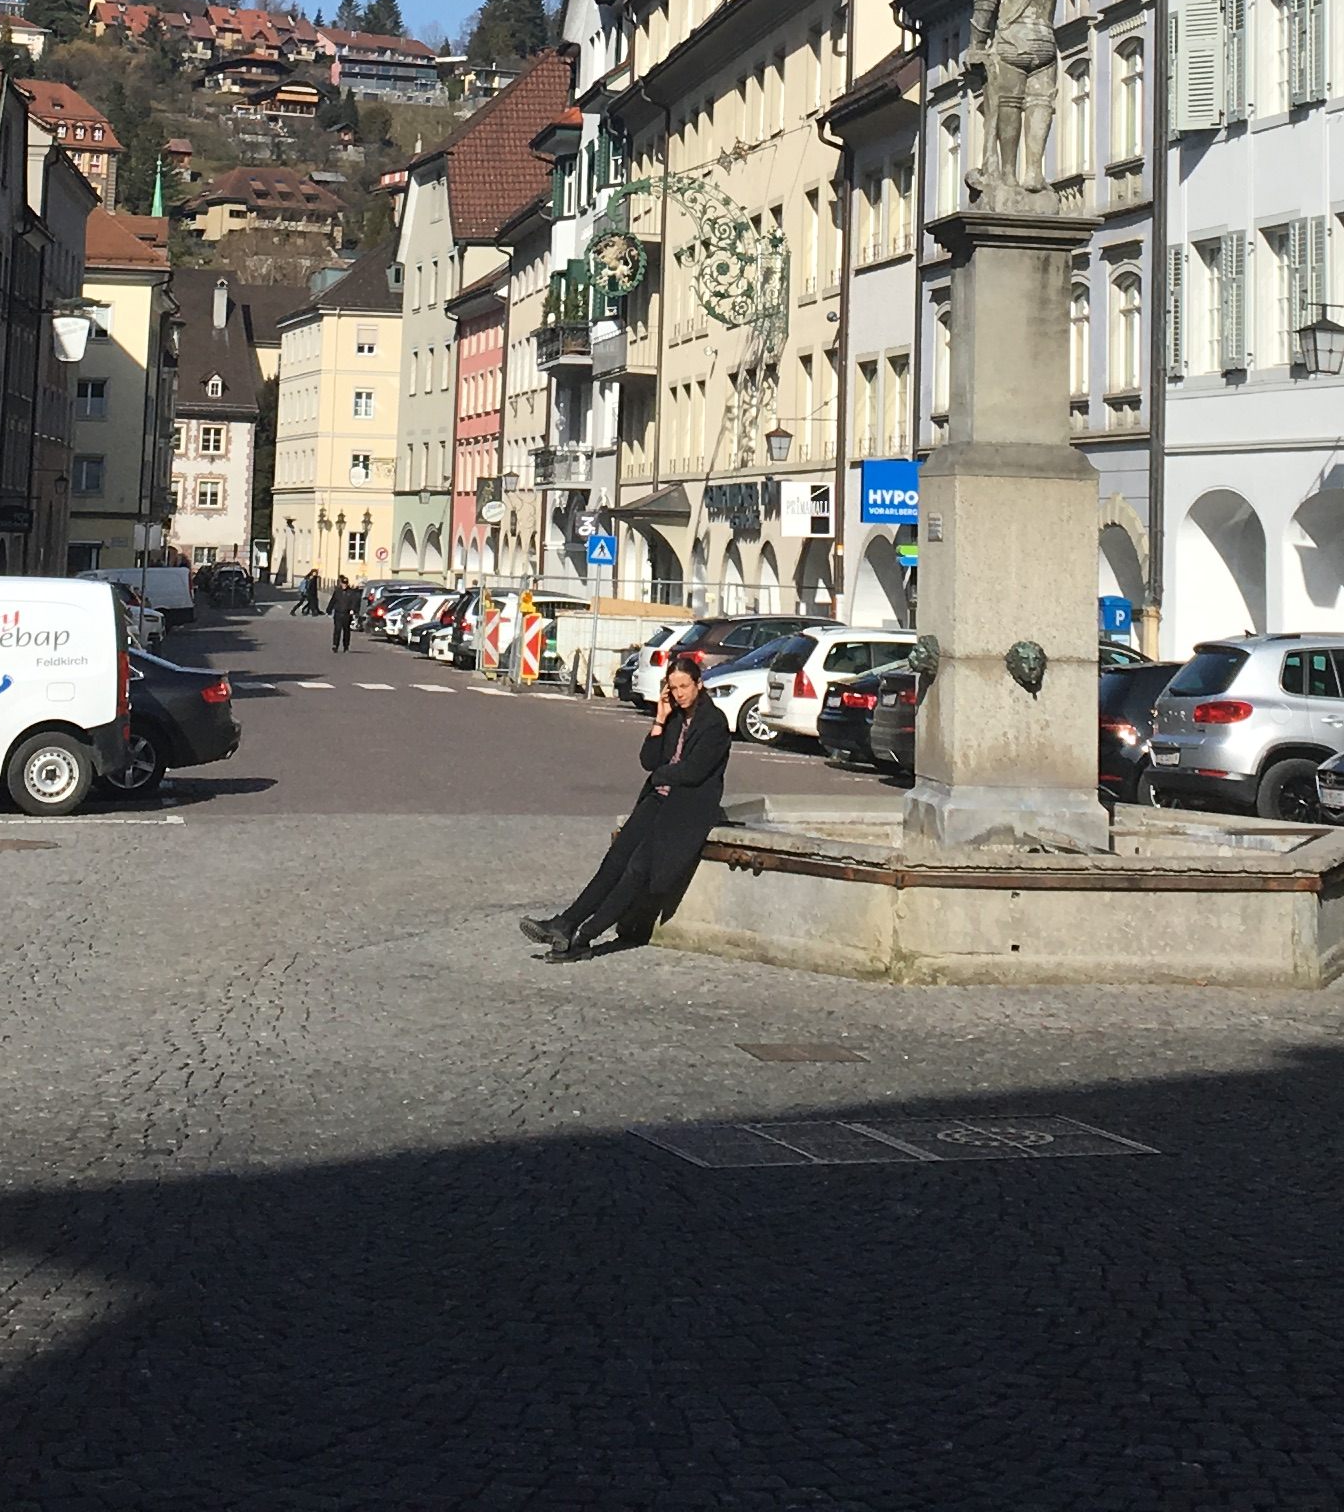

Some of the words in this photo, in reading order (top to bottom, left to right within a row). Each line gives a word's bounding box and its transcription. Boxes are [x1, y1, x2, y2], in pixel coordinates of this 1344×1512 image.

[868, 488, 919, 506] HYPO
[868, 507, 918, 516] VORARLBERG
[1115, 609, 1126, 627] P
[36, 656, 88, 667] Feldkirch
